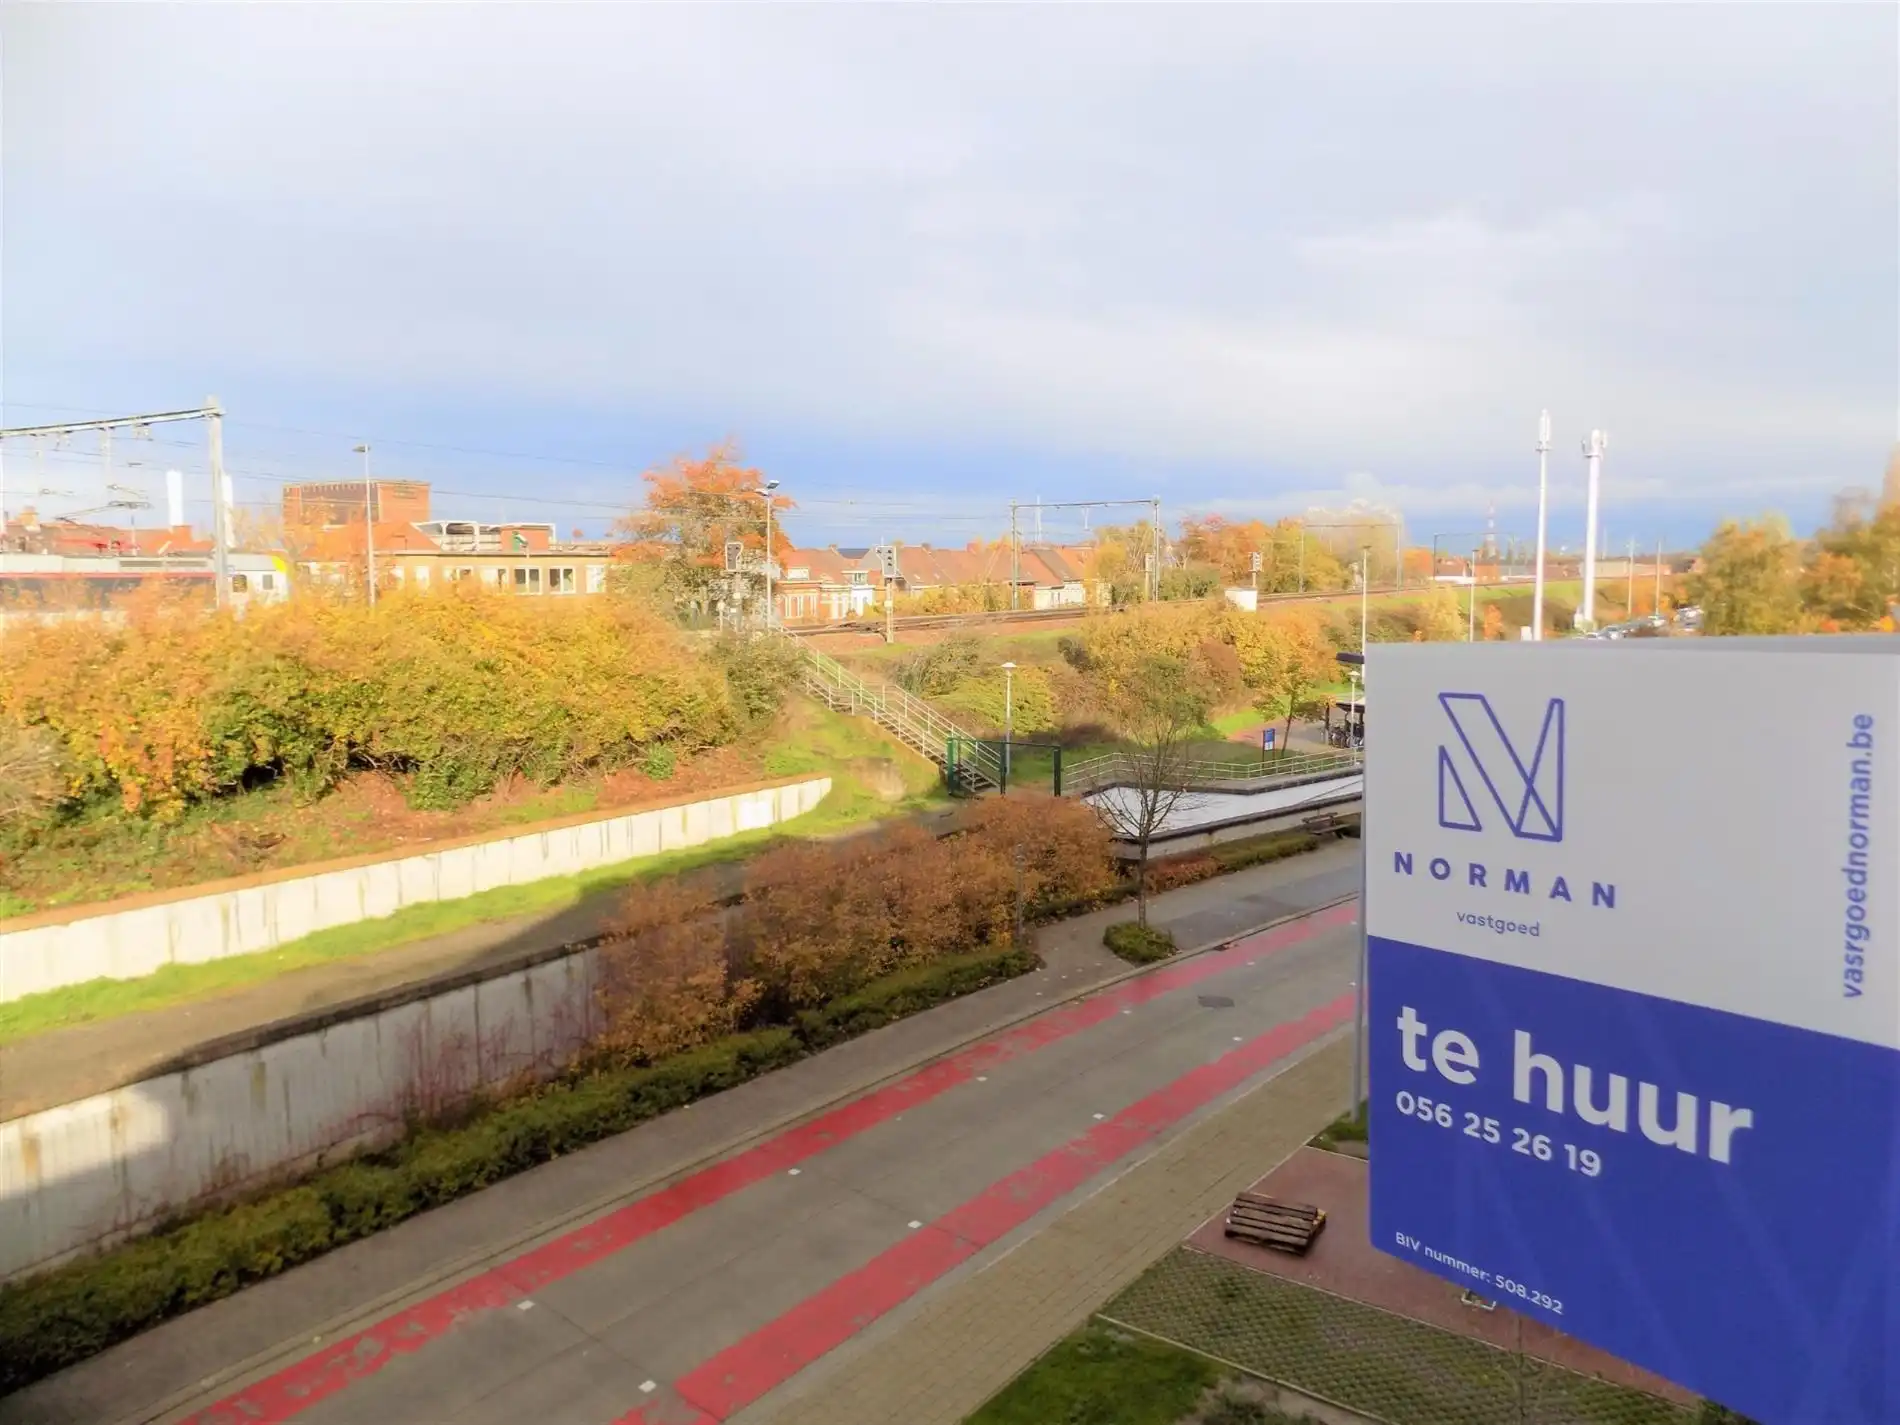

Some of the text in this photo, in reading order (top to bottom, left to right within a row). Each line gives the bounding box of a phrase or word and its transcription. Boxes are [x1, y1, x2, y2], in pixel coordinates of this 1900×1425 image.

[1394, 851, 1616, 908] NORMAN
[1456, 911, 1540, 937] vastgoed
[1397, 1006, 1753, 1164] te huur
[1396, 1091, 1601, 1177] 056 25 26 19
[1396, 1232, 1420, 1251] BIV
[1425, 1245, 1491, 1283] nummer:
